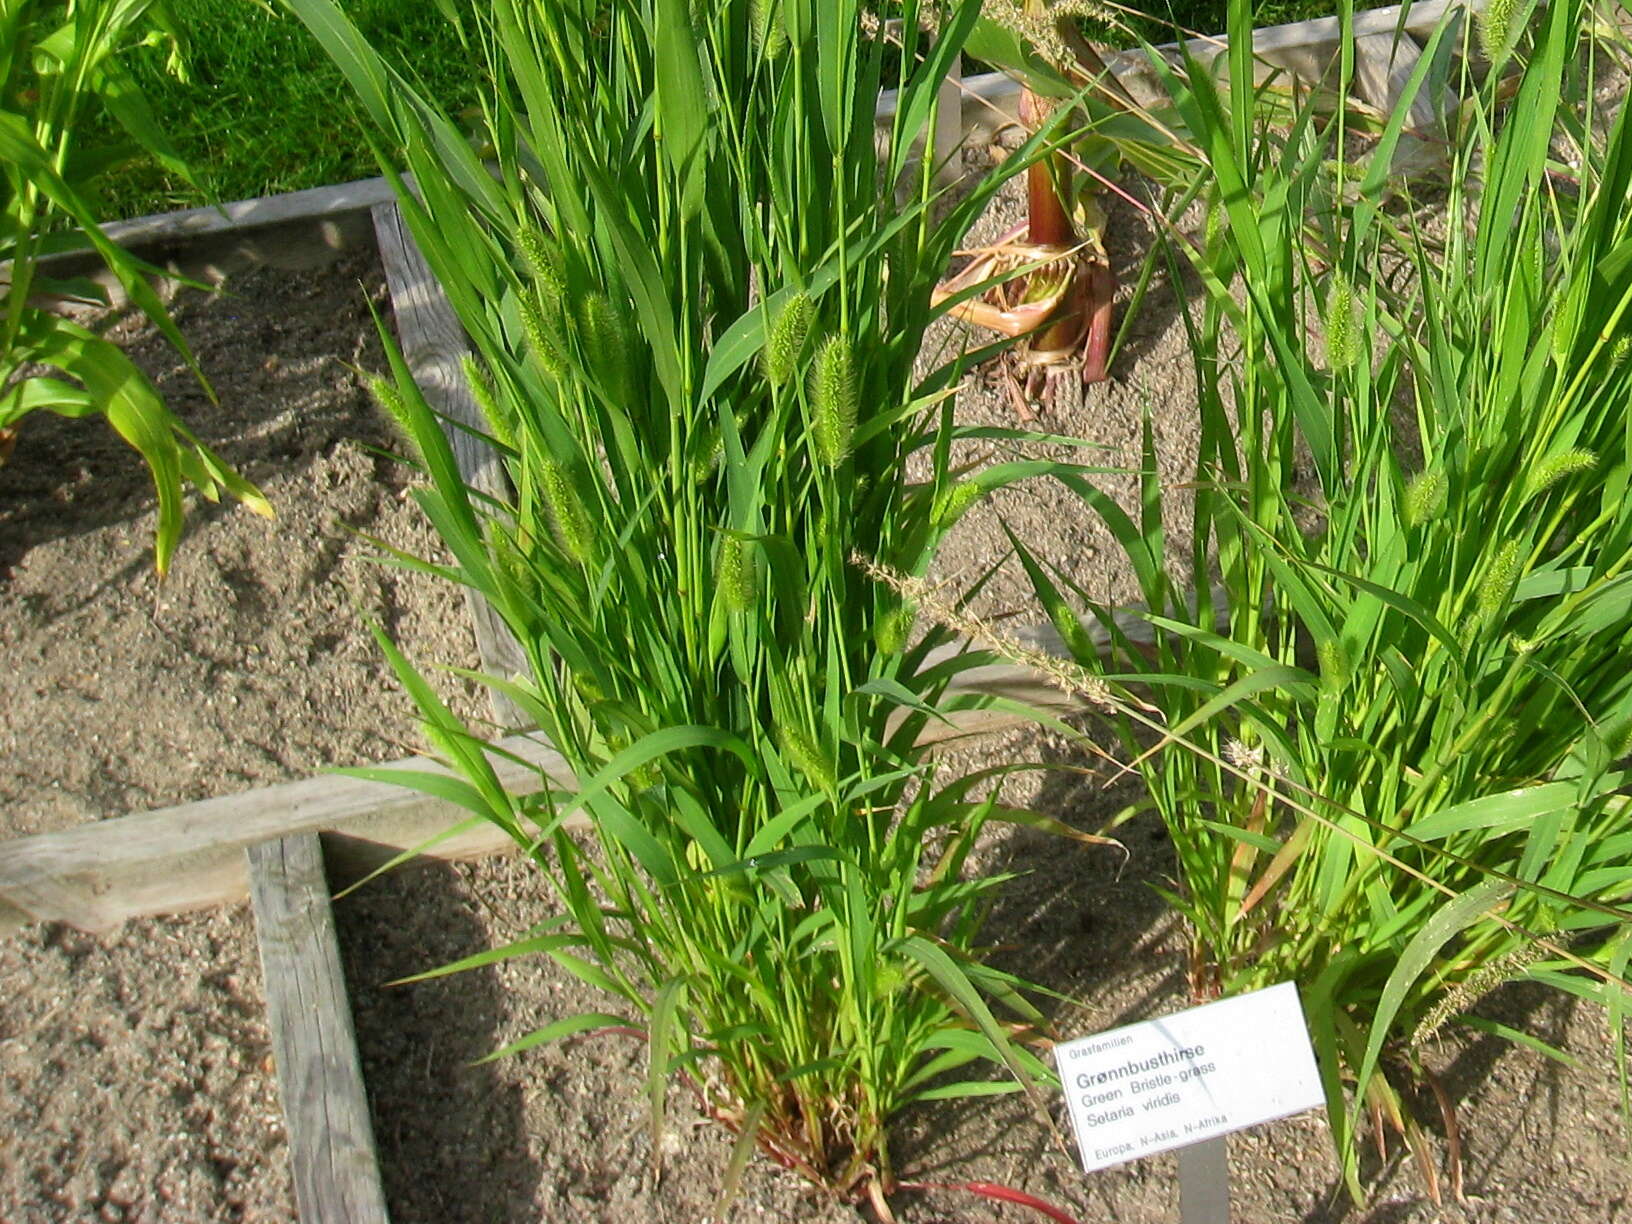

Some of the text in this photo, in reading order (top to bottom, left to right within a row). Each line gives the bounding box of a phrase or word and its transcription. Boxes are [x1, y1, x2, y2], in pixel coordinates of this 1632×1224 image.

[1069, 1035, 1134, 1060] Grasfamilien
[1076, 1043, 1205, 1090] Grønnbusthirse
[1081, 1088, 1124, 1108] Green
[1087, 1091, 1181, 1128] Setaria viridis
[1184, 1114, 1229, 1133] N-Afrika
